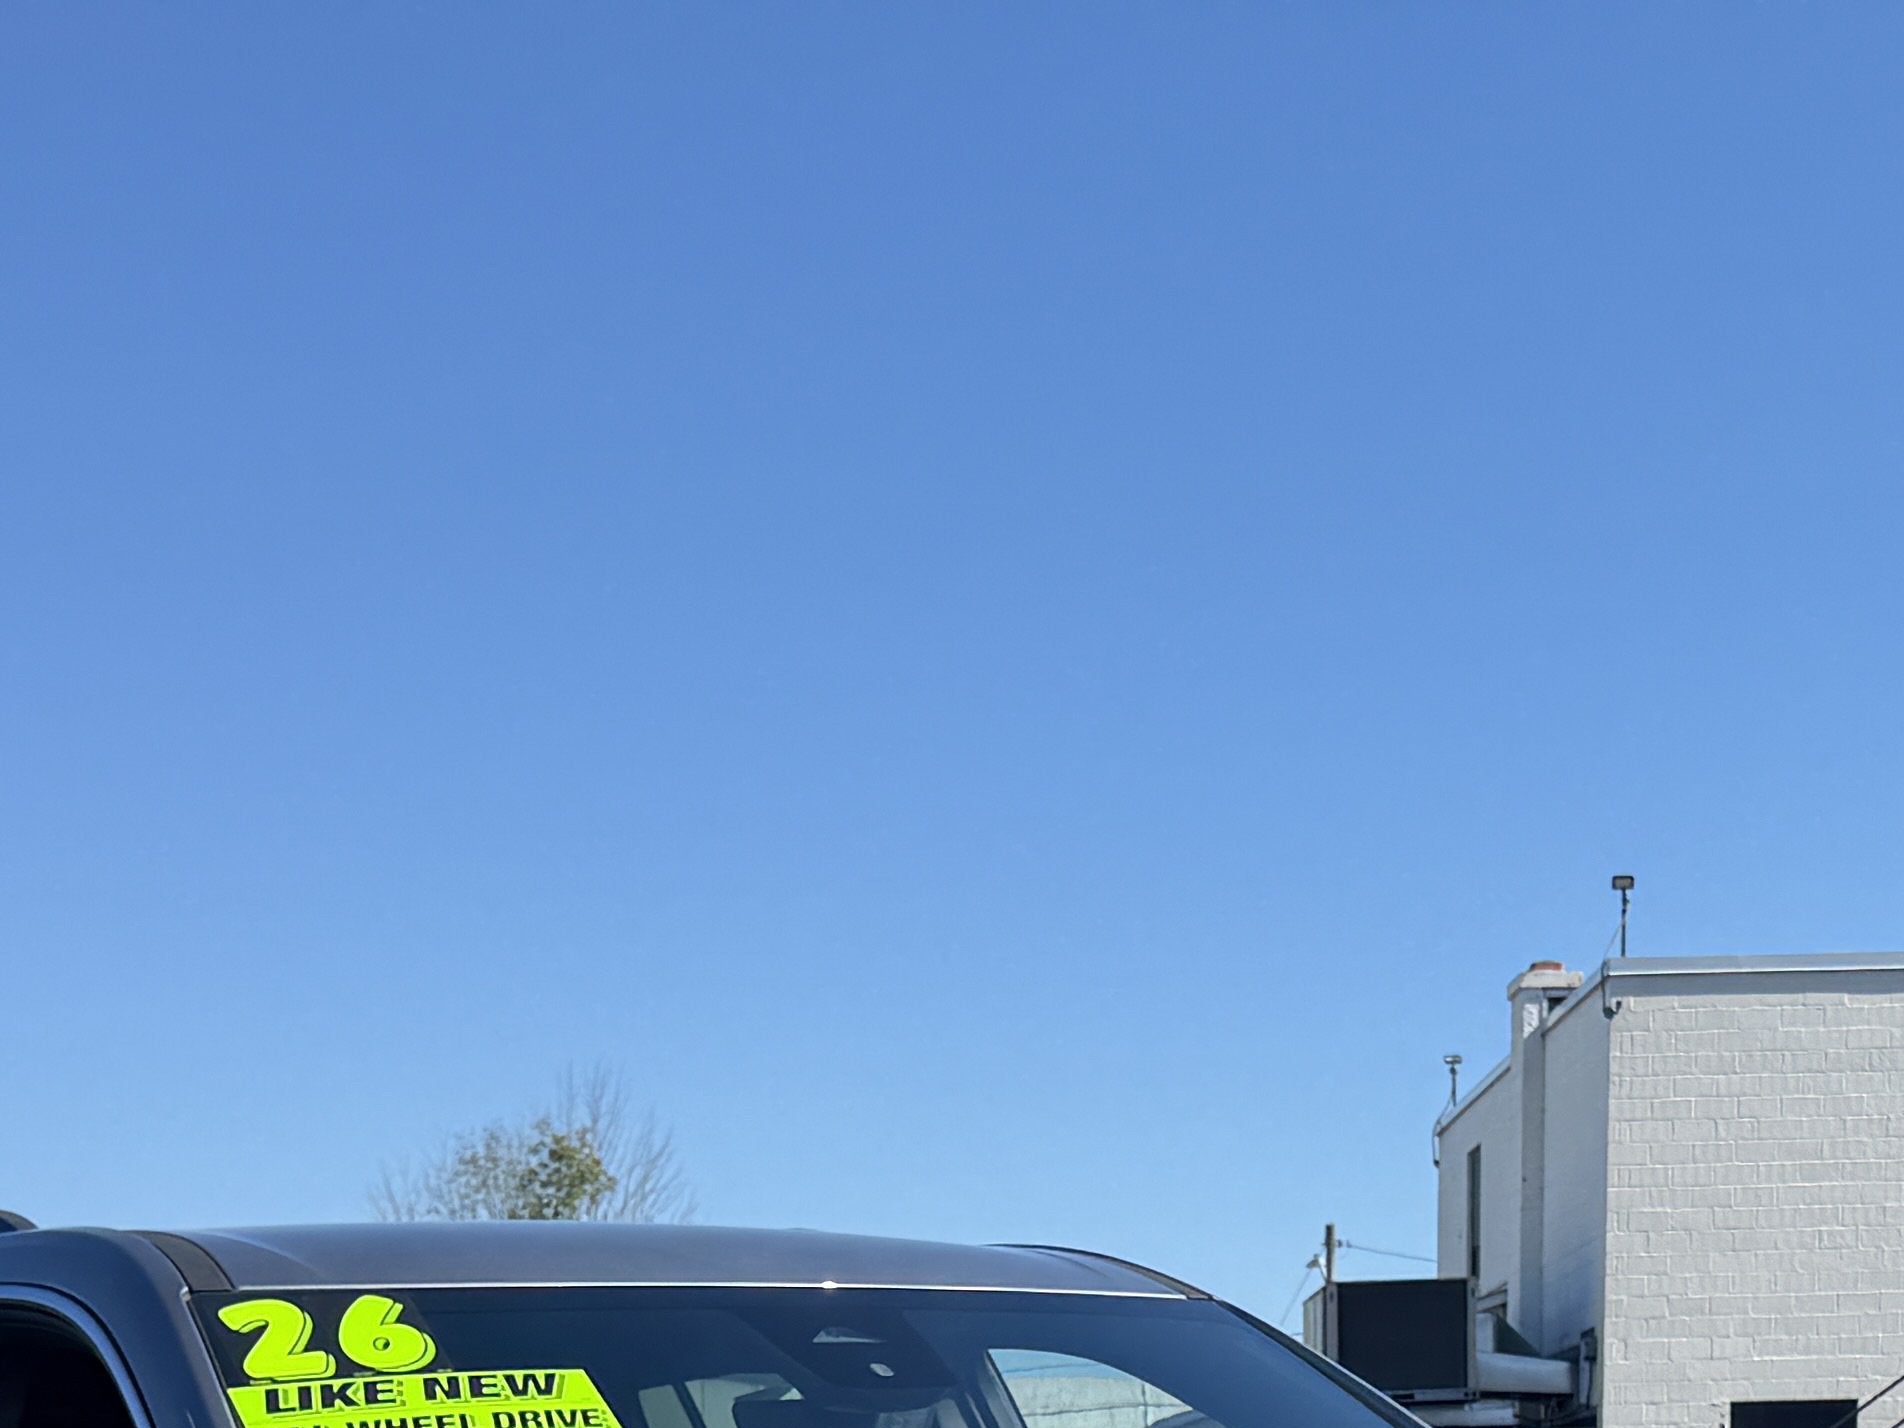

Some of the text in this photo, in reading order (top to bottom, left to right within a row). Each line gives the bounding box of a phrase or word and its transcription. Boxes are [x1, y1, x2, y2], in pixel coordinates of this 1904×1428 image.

[217, 1294, 436, 1379] 26
[264, 1373, 560, 1415] LIKE NEW
